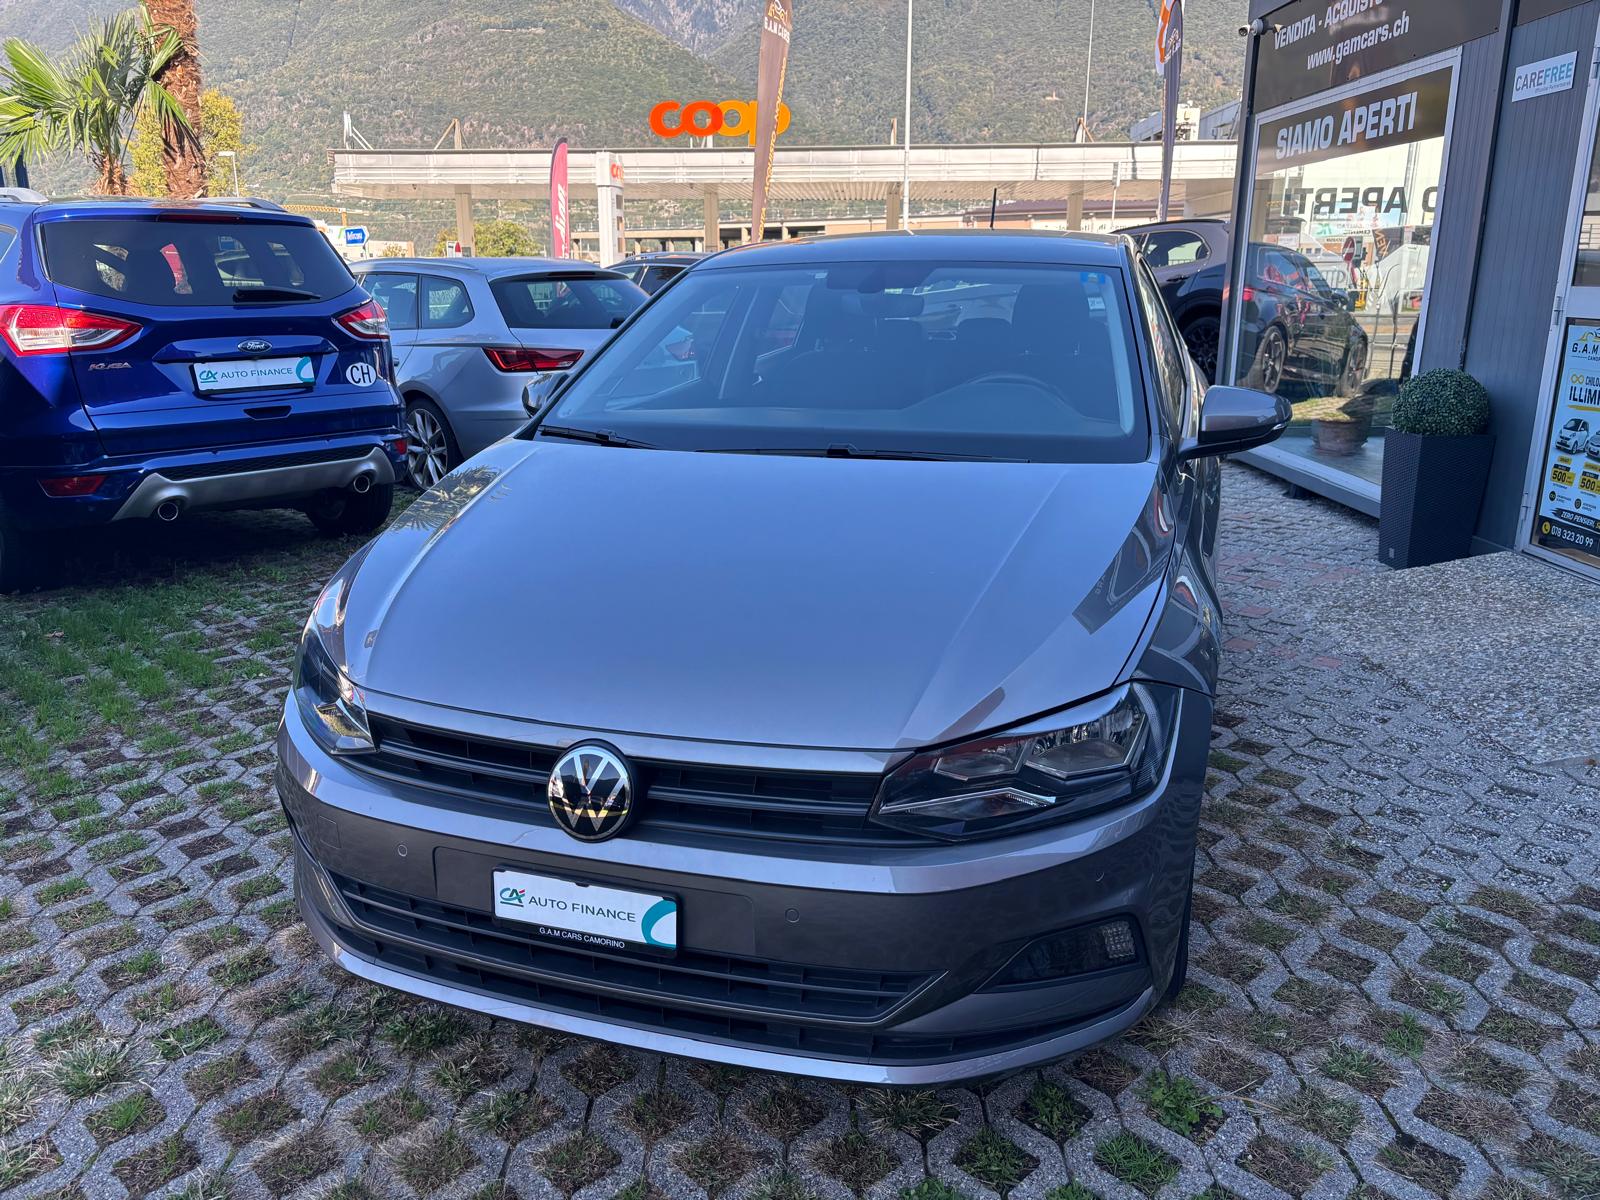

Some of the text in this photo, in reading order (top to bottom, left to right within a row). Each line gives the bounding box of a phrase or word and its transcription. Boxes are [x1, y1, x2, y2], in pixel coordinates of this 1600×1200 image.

[1274, 14, 1316, 50] VENDITA
[1324, 0, 1380, 28] ACQUIS
[1307, 10, 1410, 70] www.gamcars.ch
[1515, 61, 1574, 92] CAREFREE
[1275, 91, 1418, 160] SIAMO APERTI
[246, 341, 266, 350] Ford
[220, 370, 249, 380] AUTO
[250, 367, 294, 377] FINANCE
[350, 364, 372, 384] CH
[1552, 469, 1567, 483] 500
[1580, 477, 1596, 491] 500
[1561, 511, 1574, 519] ZERO
[1551, 525, 1594, 548] 078 323 20 99
[528, 895, 568, 911] AUTO
[572, 902, 637, 923] FINANCE
[561, 931, 583, 942] CARS
[584, 934, 626, 949] CAMORINO
